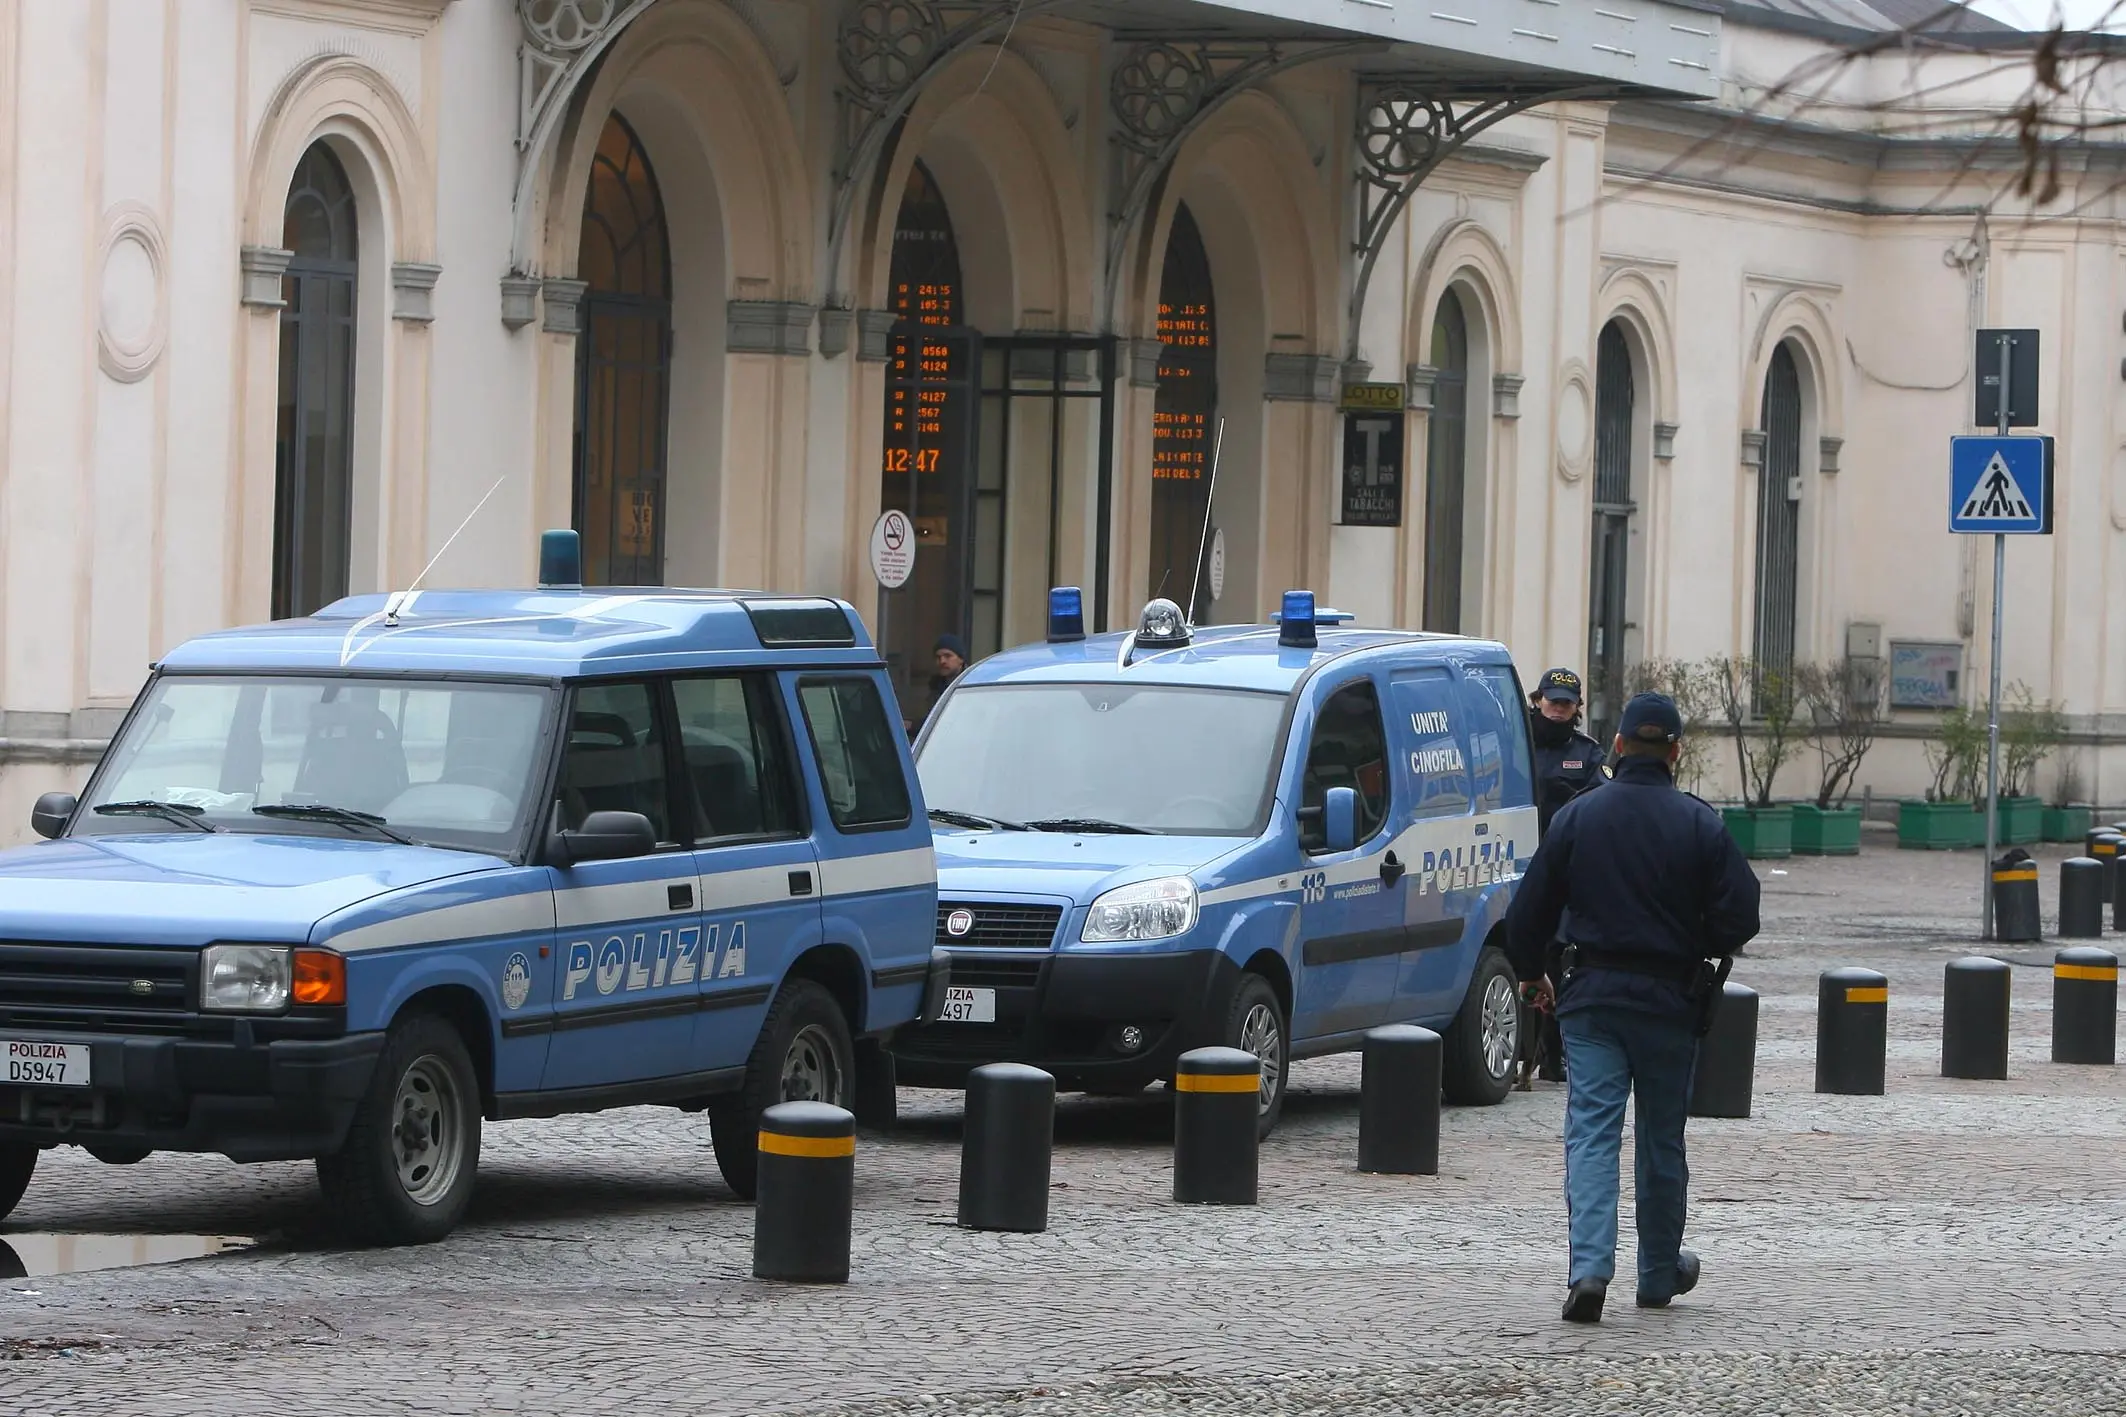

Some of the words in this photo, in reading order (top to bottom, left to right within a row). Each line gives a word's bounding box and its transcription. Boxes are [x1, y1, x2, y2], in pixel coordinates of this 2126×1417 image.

[885, 448, 940, 472] 12:47
[1410, 711, 1448, 734] UNITA'
[1410, 748, 1464, 774] CINOFILA
[1420, 839, 1515, 896] POLIZIA
[1301, 871, 1326, 904] 113
[951, 917, 968, 930] FIAT
[563, 920, 746, 1001] POLIZIA
[945, 989, 975, 1001] IZIA
[9, 1042, 67, 1059] POLIZIA
[10, 1060, 67, 1083] D5947
